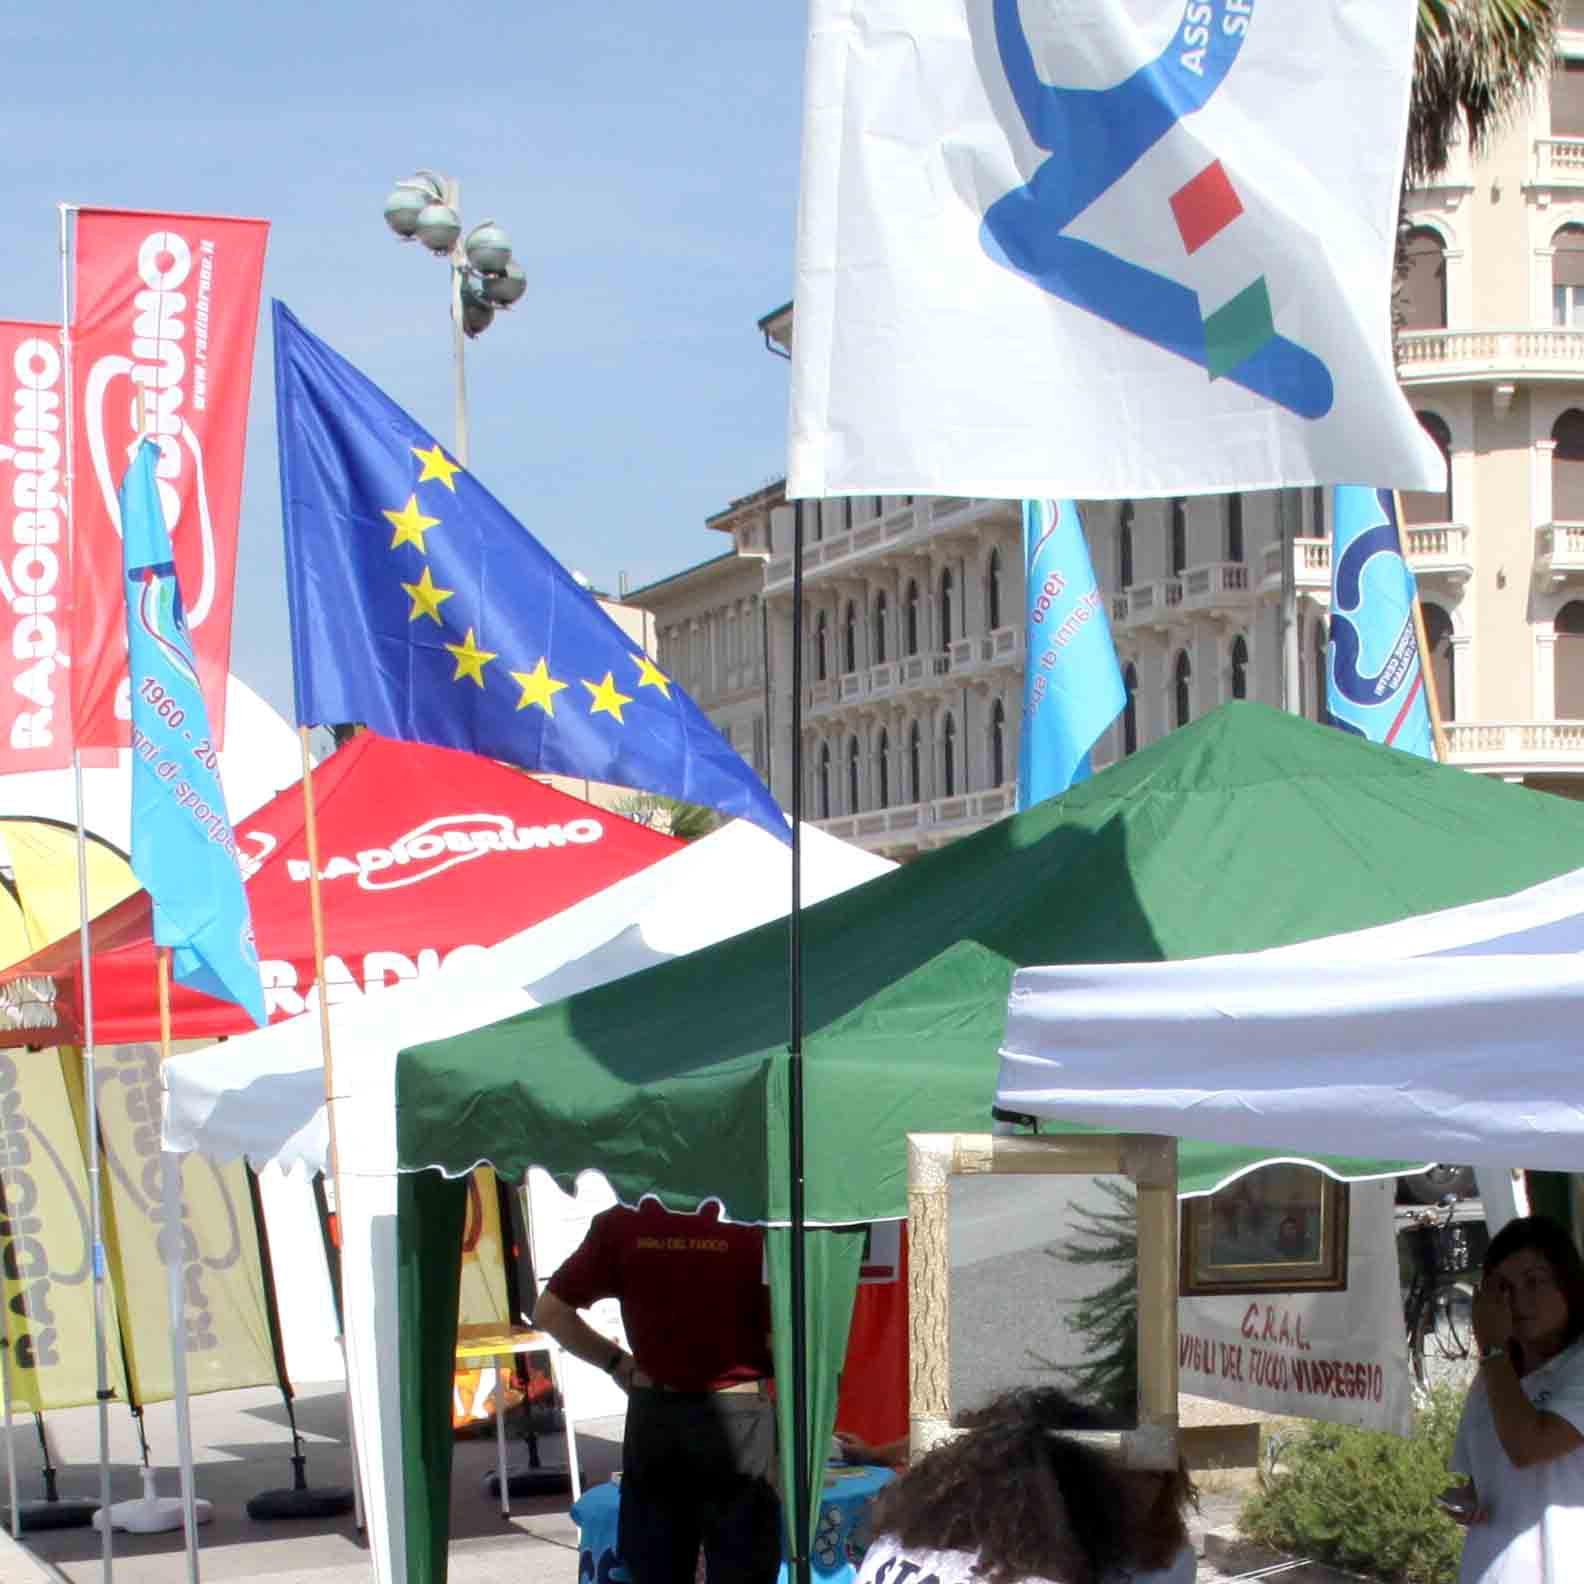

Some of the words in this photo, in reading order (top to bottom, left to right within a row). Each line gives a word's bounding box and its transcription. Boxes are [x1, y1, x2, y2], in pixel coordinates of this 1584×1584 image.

[10, 338, 61, 748] RADIOBRUNO
[139, 678, 185, 729] 1960
[157, 759, 180, 781] di
[287, 817, 604, 882] RADIOBRUNO
[1220, 1342, 1244, 1382] DEL
[1290, 1356, 1383, 1404] VIAREGGIO
